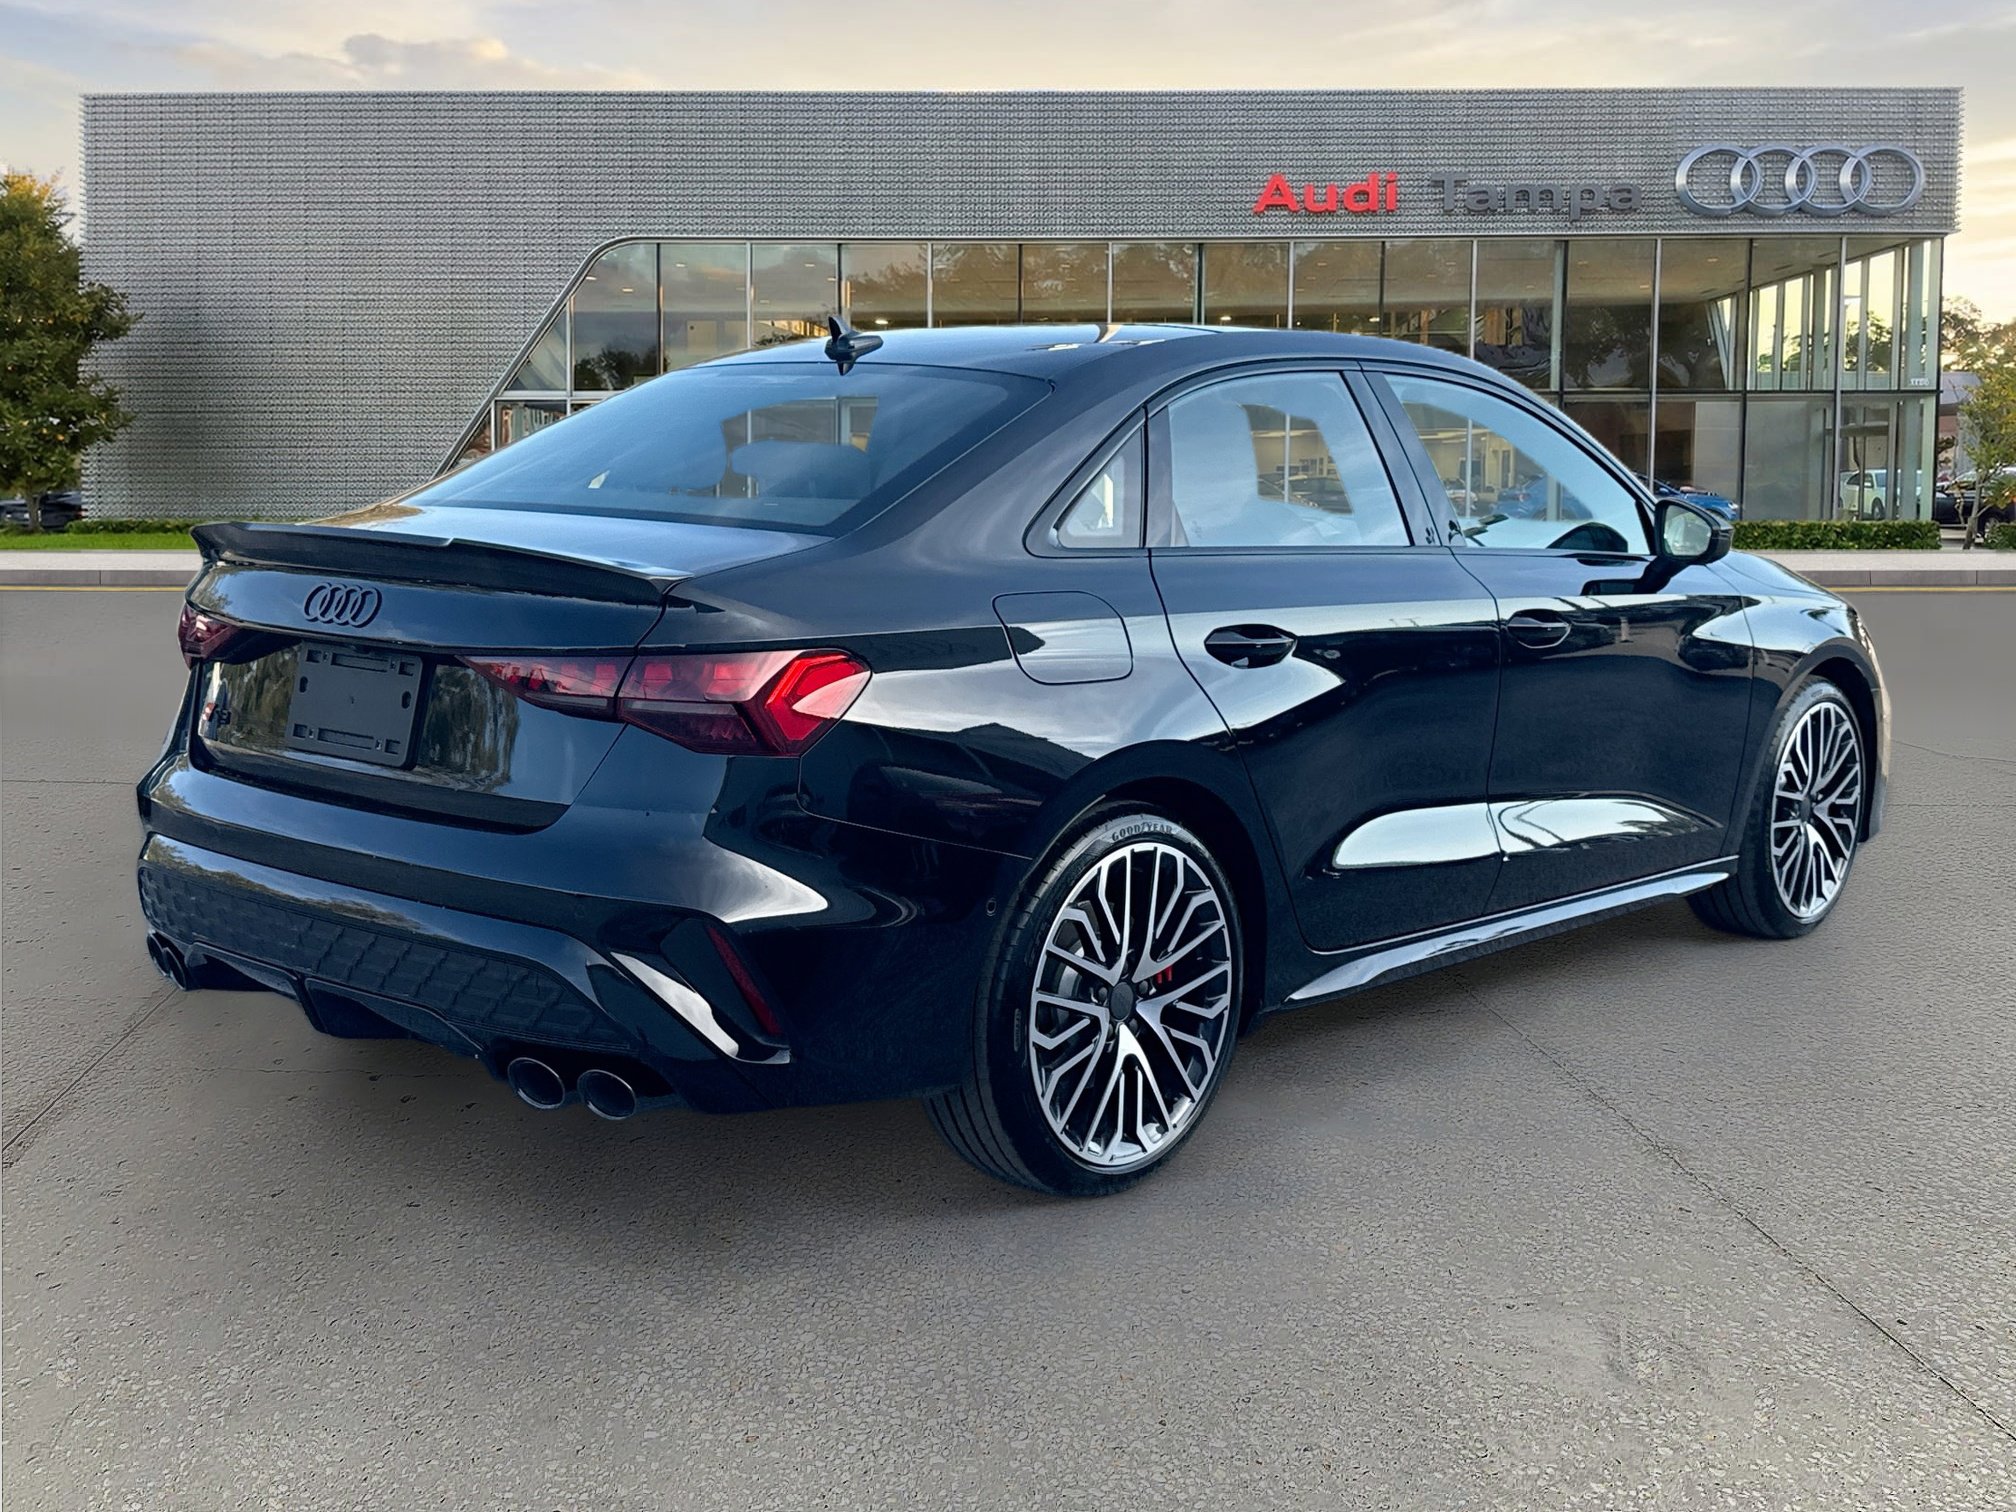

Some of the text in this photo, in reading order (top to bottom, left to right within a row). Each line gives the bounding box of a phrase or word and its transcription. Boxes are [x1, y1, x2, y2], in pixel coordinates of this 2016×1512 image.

[1253, 172, 1642, 222] Audi Tampa
[1111, 821, 1173, 841] GOODYEAR
